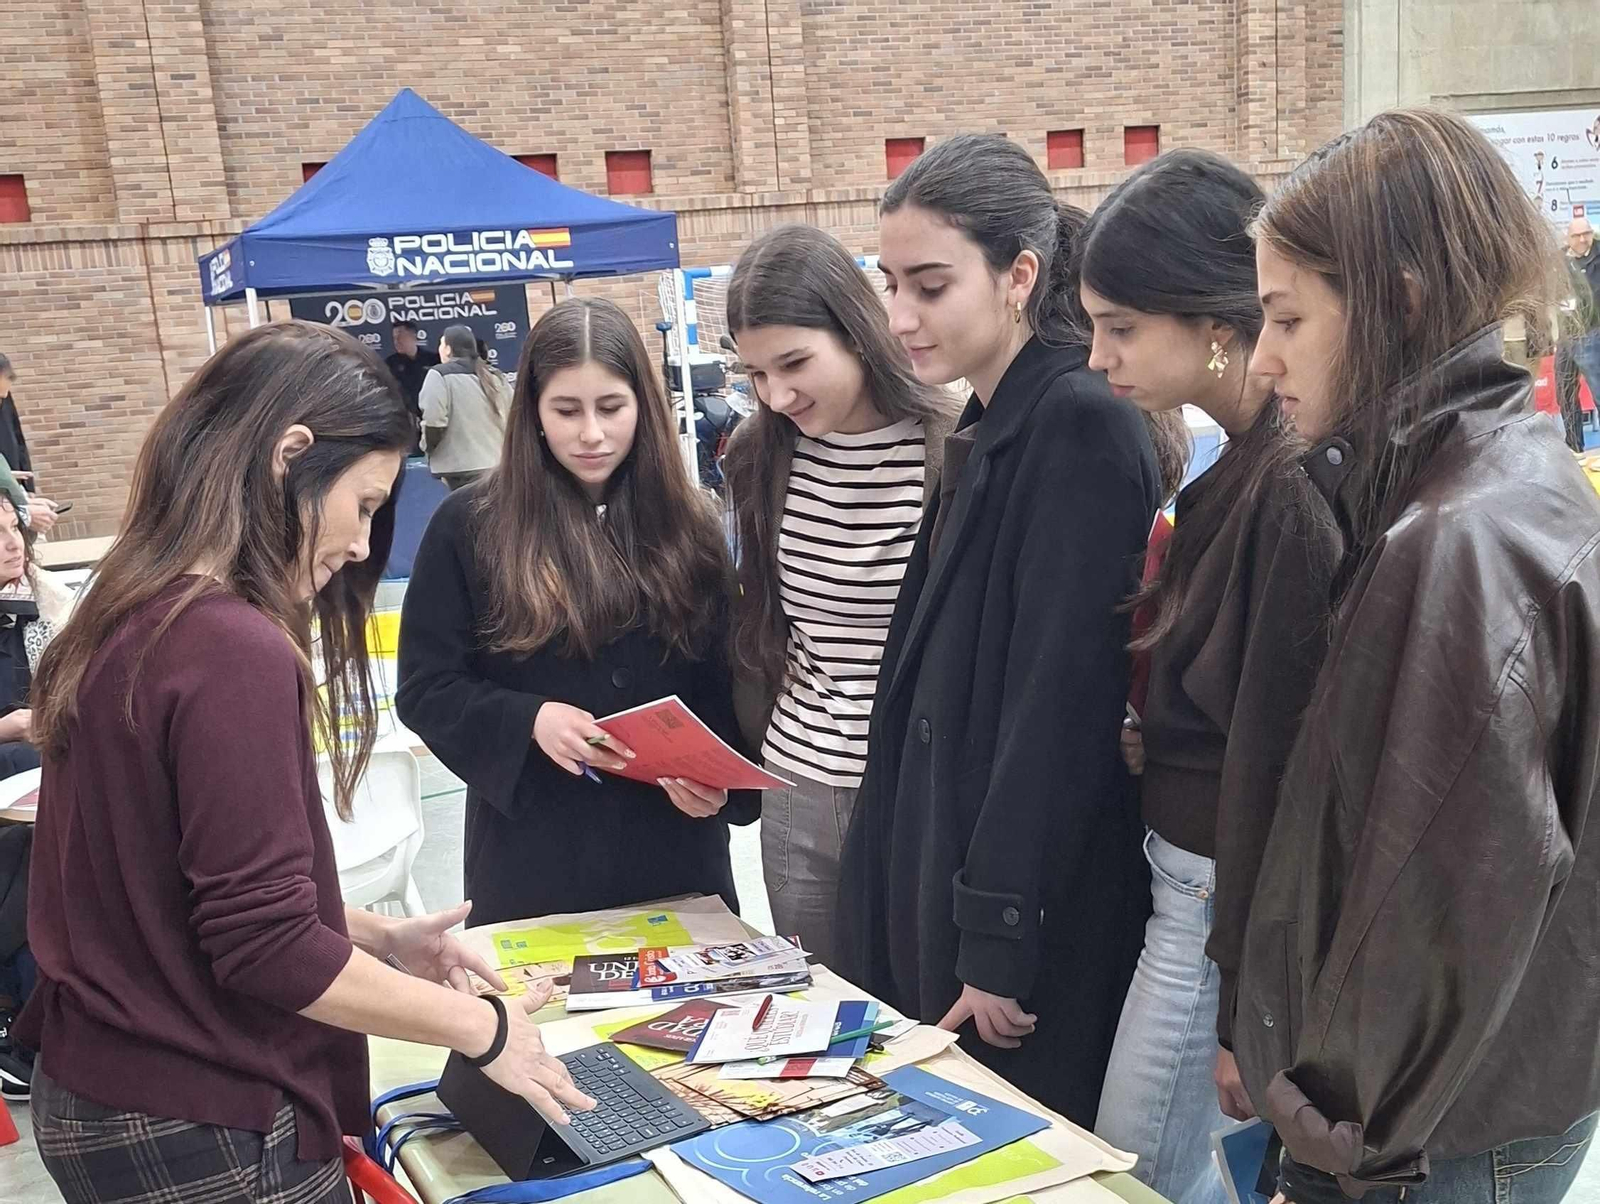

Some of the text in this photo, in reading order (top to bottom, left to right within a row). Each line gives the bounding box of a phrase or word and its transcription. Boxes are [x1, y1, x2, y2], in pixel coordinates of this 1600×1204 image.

[1527, 135, 1544, 143] estas
[1547, 133, 1556, 141] 10
[1551, 156, 1559, 170] 6
[1536, 180, 1543, 194] 7
[1551, 199, 1558, 211] 8
[393, 229, 537, 254] POLICIA
[396, 249, 574, 277] NACIONAL
[388, 292, 474, 309] POLICIA
[389, 303, 498, 323] NACIONAL
